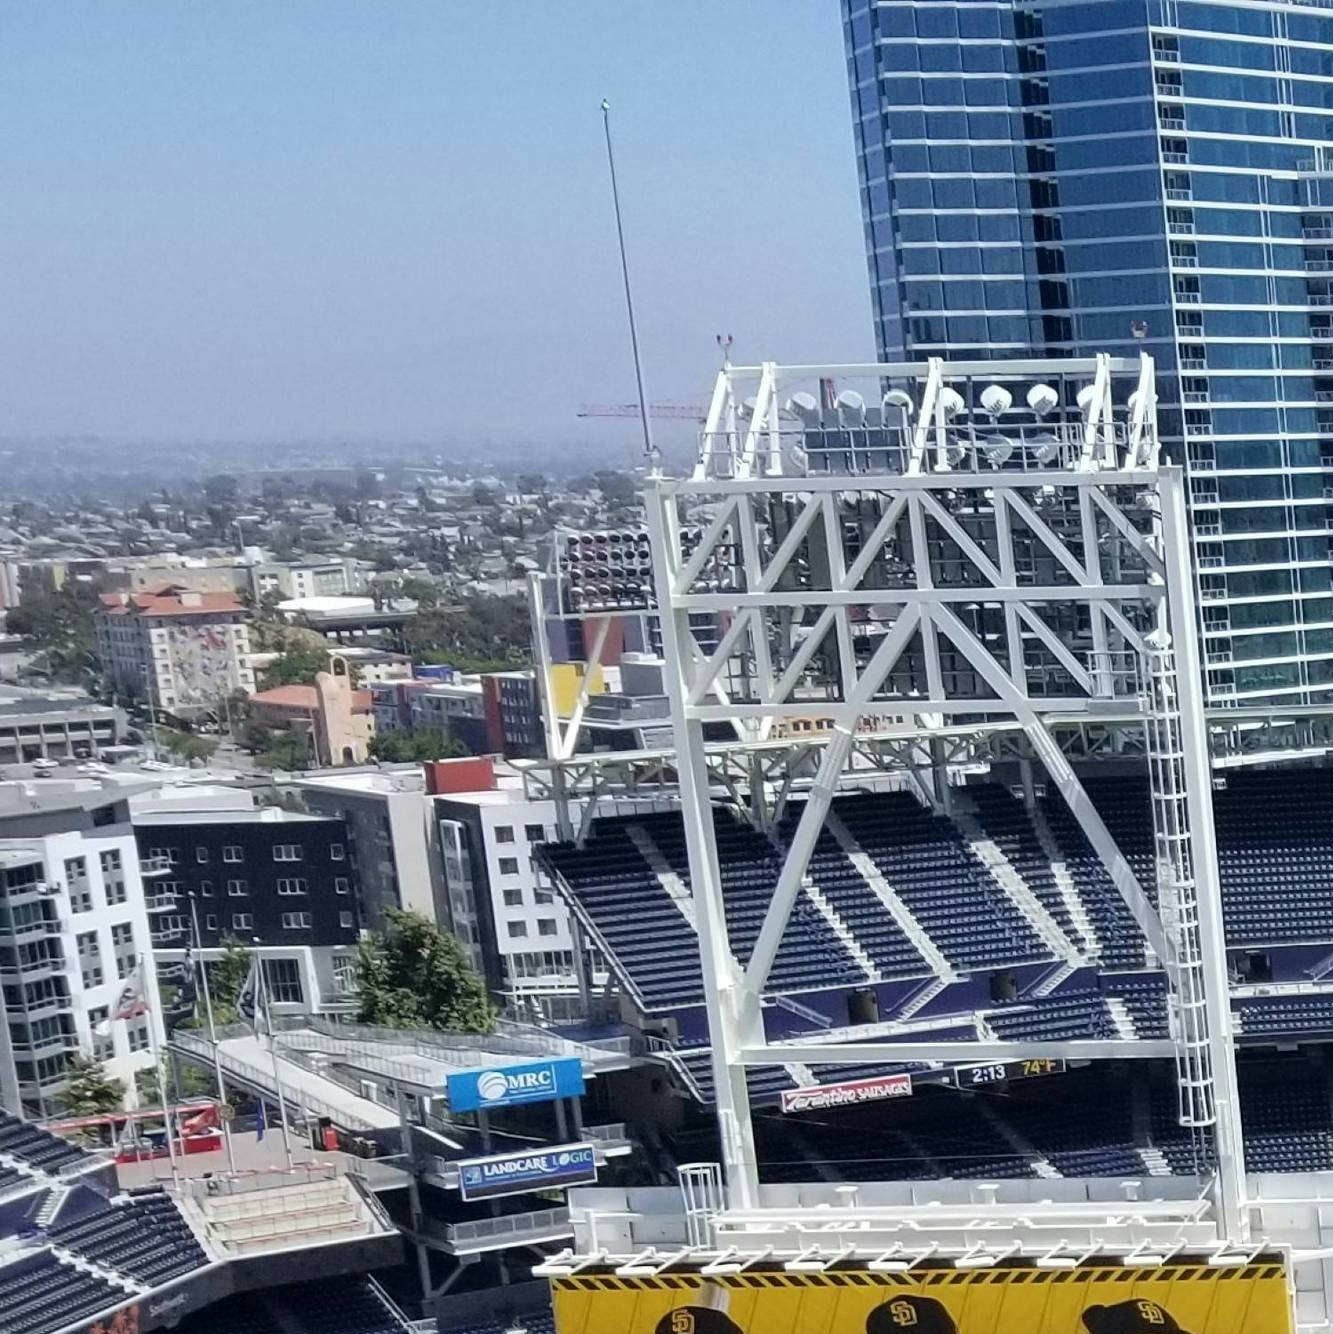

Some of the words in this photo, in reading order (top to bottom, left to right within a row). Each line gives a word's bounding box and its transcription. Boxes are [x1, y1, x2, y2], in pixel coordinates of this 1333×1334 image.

[507, 1070, 551, 1089] MRC
[971, 1064, 1006, 1084] 2:13
[857, 1080, 911, 1101] SAUSAGES
[483, 1156, 547, 1177] LANDCARE
[890, 1299, 918, 1327] SD
[1138, 1300, 1166, 1325] SD
